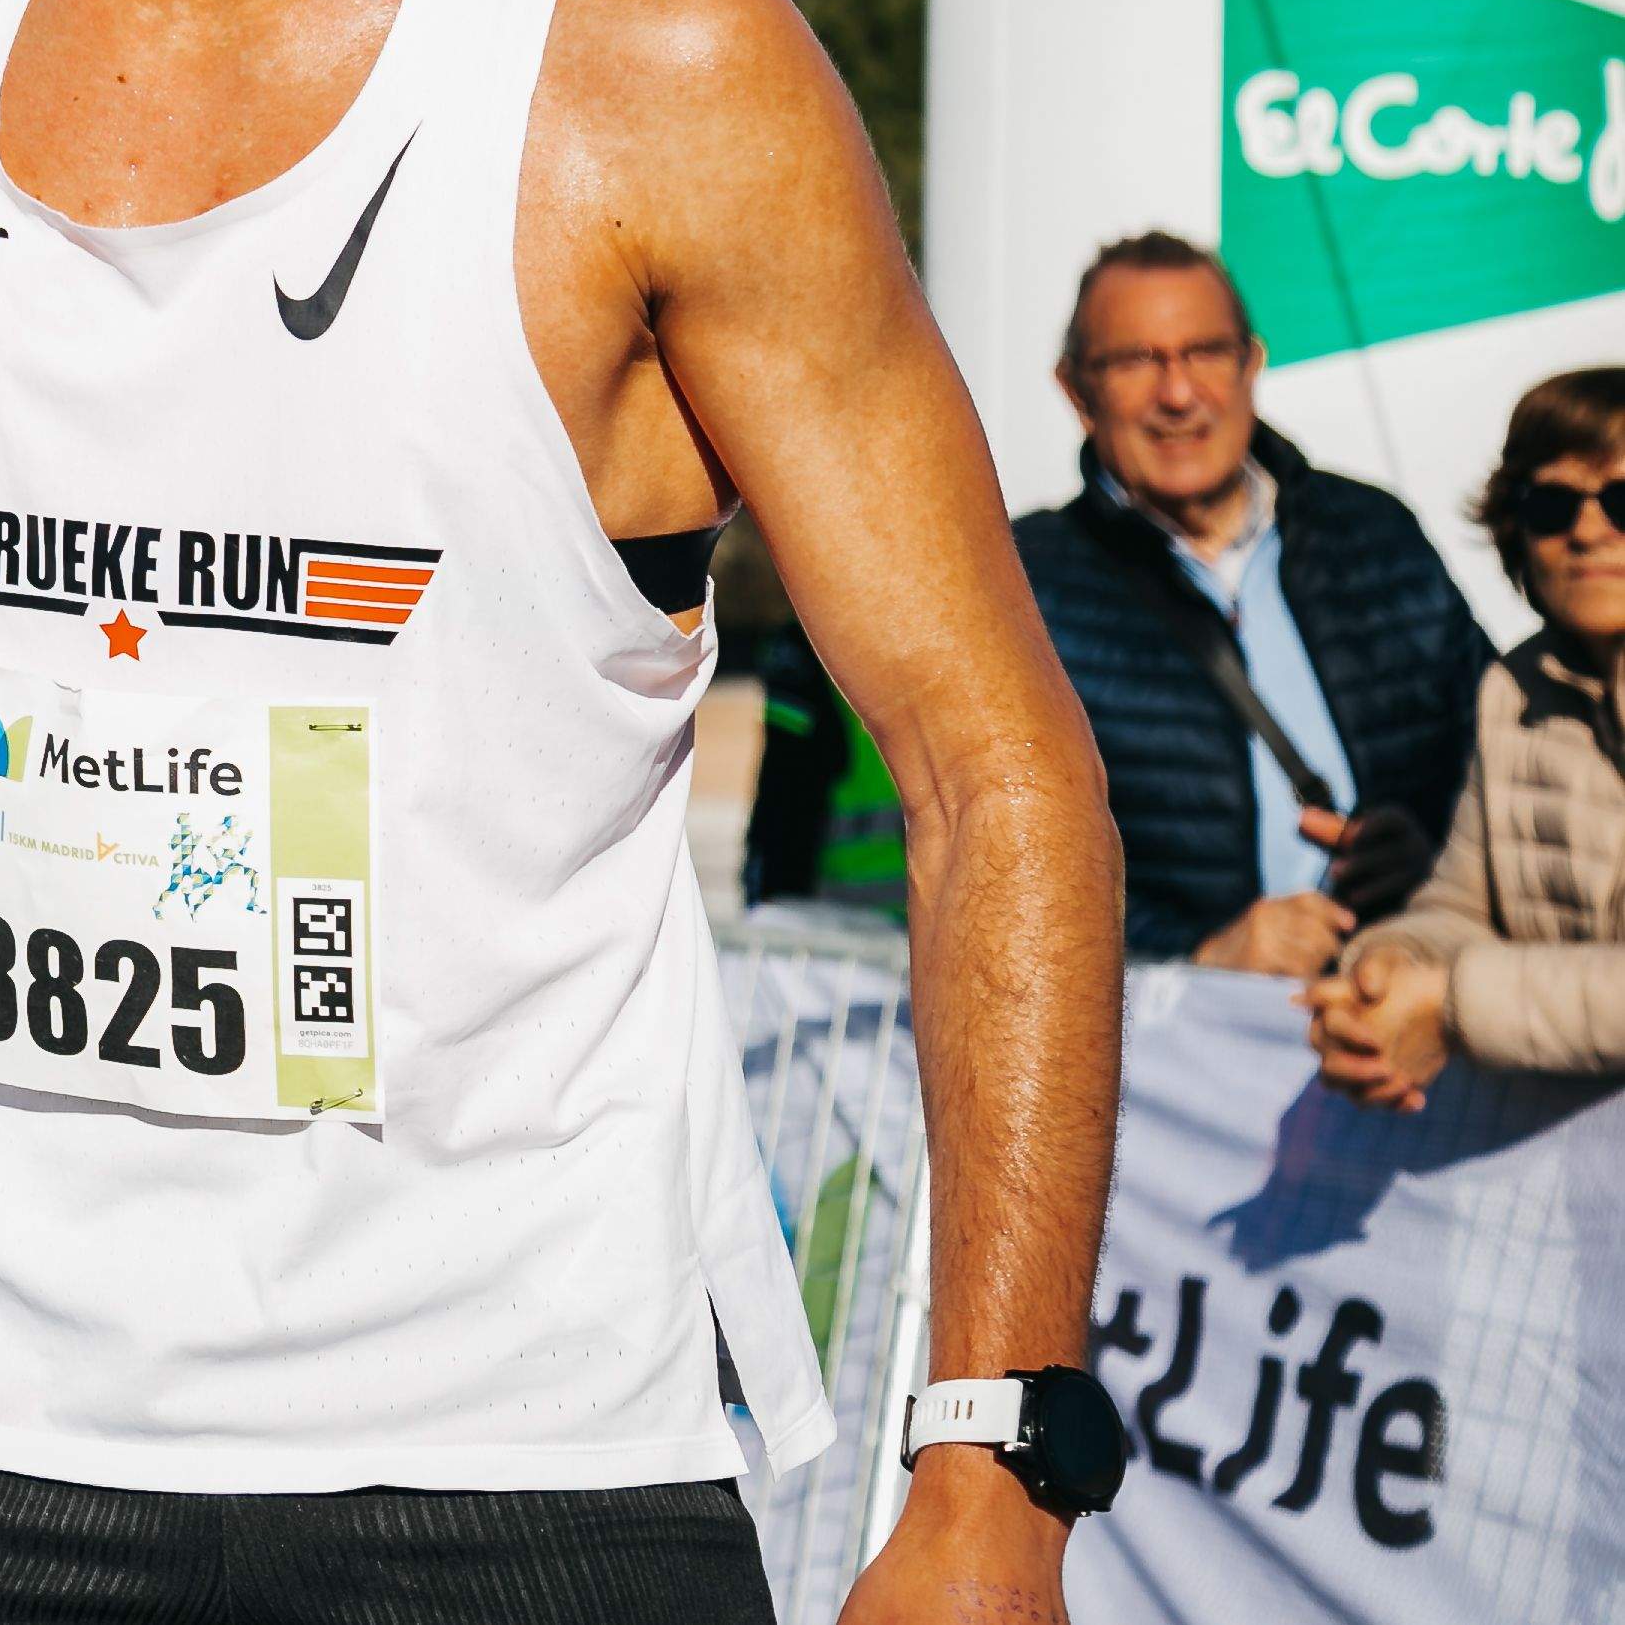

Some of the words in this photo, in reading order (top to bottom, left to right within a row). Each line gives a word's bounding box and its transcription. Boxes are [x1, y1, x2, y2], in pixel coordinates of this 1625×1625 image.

[1235, 68, 1344, 178] El
[1342, 72, 1583, 183] Corte
[177, 531, 301, 616] RUN
[39, 732, 243, 797] MetLife
[8, 831, 37, 850] 15KM
[40, 840, 95, 861] MADRID
